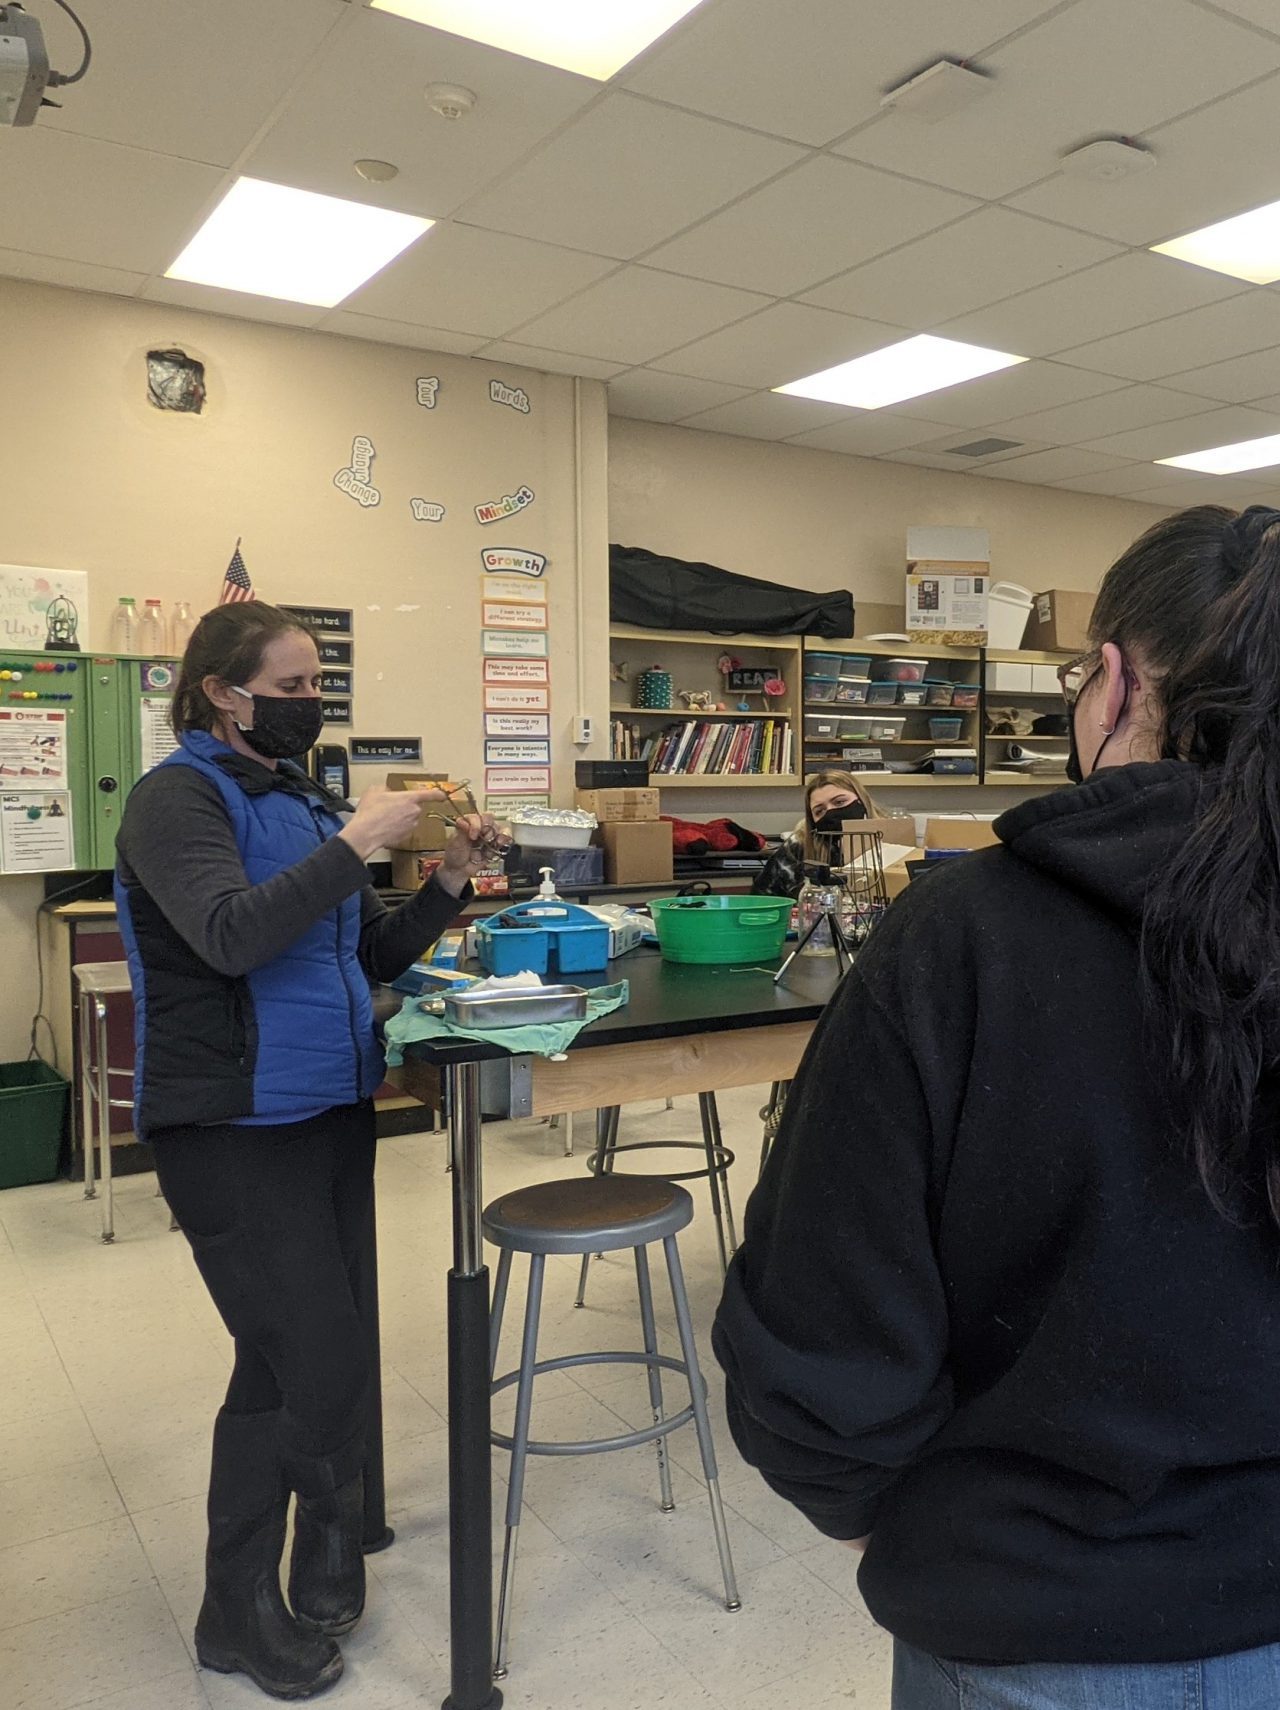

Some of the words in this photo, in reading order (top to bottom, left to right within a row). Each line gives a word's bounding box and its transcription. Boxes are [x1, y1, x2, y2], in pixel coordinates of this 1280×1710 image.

[420, 379, 434, 406] Your
[492, 381, 528, 410] Words.
[337, 471, 377, 503] Change
[413, 501, 442, 518] Your
[478, 489, 532, 521] Mindset
[486, 554, 540, 572] Growth
[357, 745, 369, 754] This
[378, 747, 392, 756] easy
[393, 746, 403, 754] for
